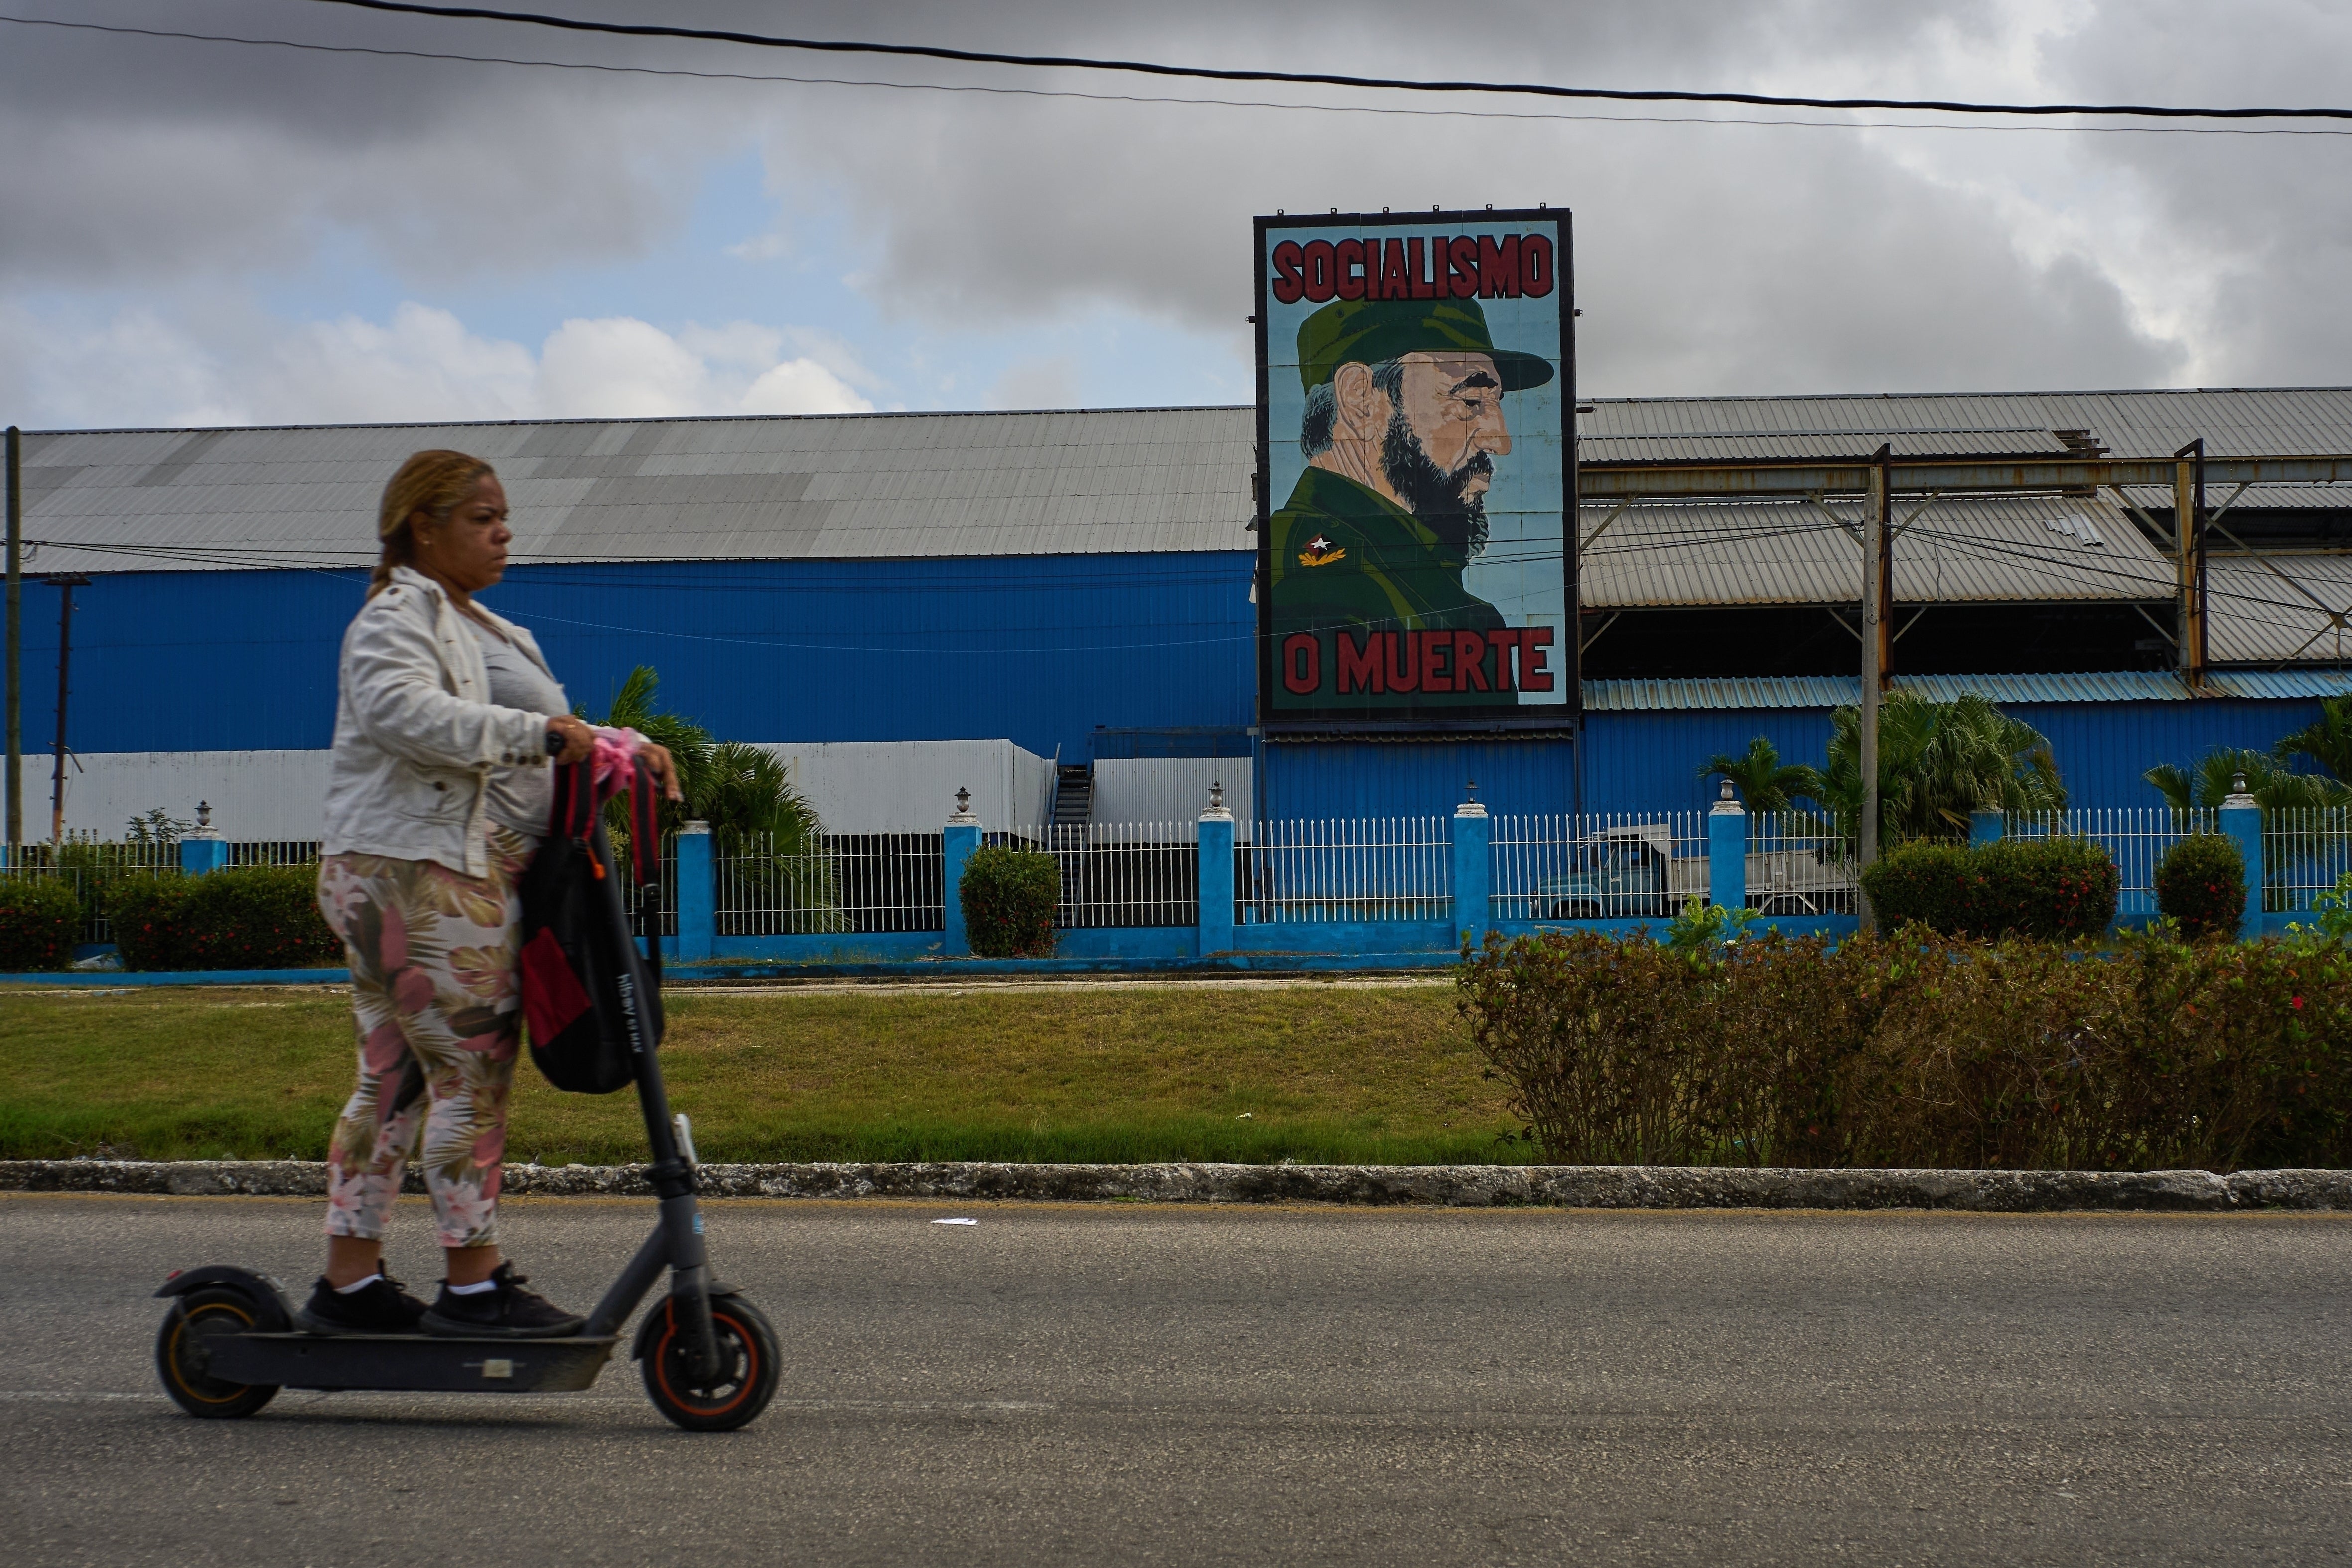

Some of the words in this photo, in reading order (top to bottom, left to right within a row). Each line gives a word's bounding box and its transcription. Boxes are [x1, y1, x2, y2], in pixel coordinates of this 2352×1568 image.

[1272, 234, 1554, 304] SOCIALISMO
[1282, 632, 1321, 696] O
[1335, 626, 1554, 695] MUERTE
